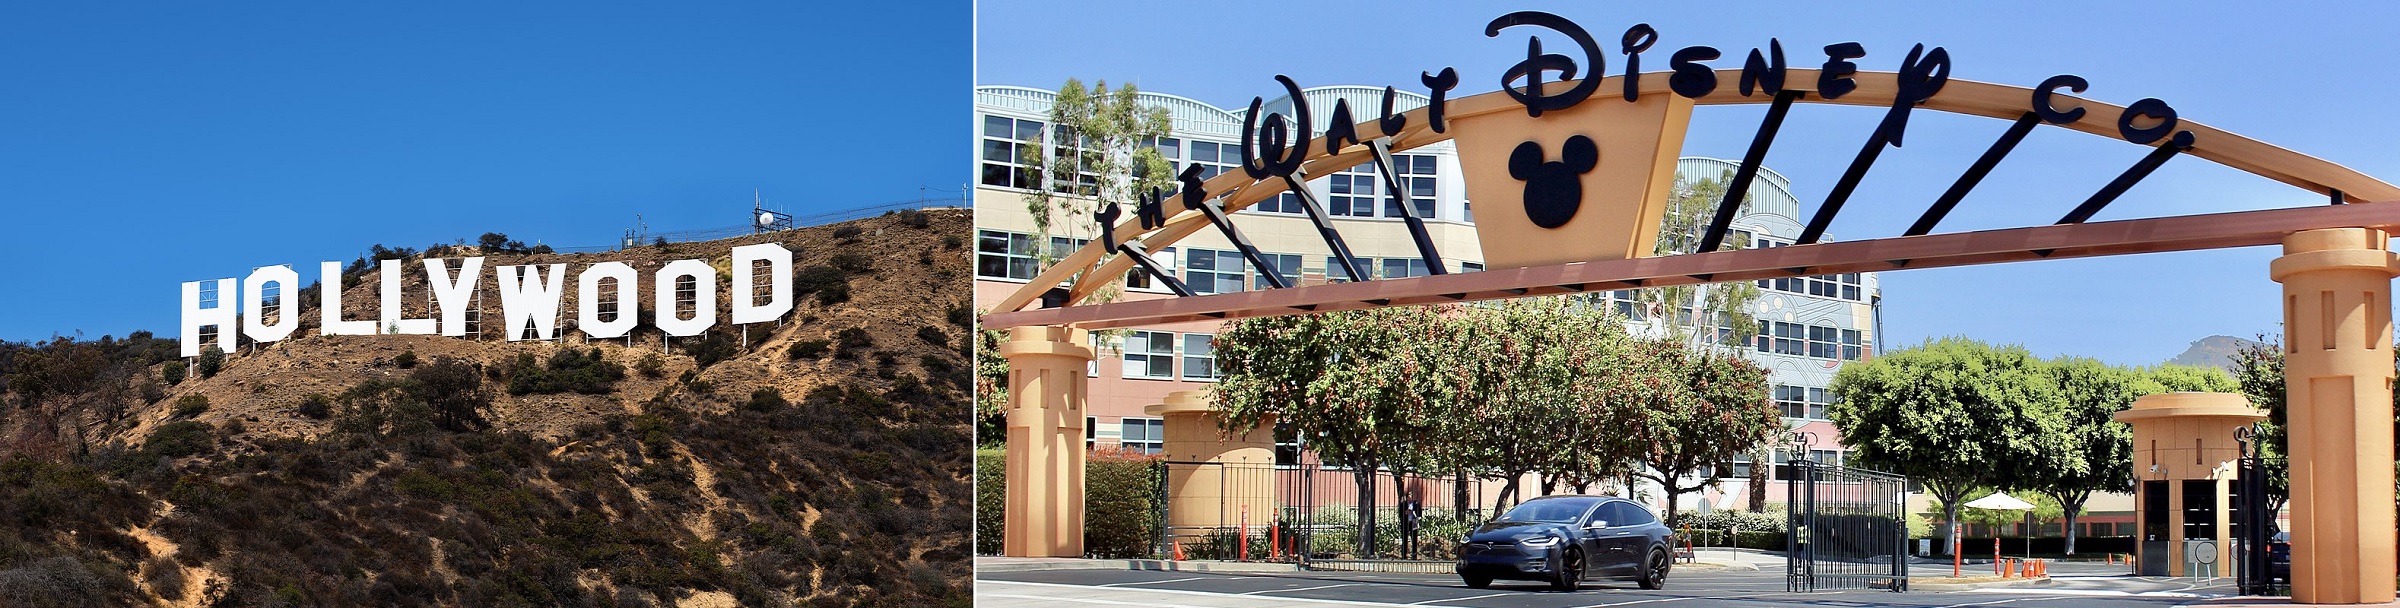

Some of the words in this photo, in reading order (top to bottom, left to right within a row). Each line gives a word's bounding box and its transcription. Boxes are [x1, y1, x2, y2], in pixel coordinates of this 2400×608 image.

[1095, 162, 1208, 255] THE
[1241, 66, 1460, 180] WALT
[181, 242, 793, 357] HOLLYWOOD
